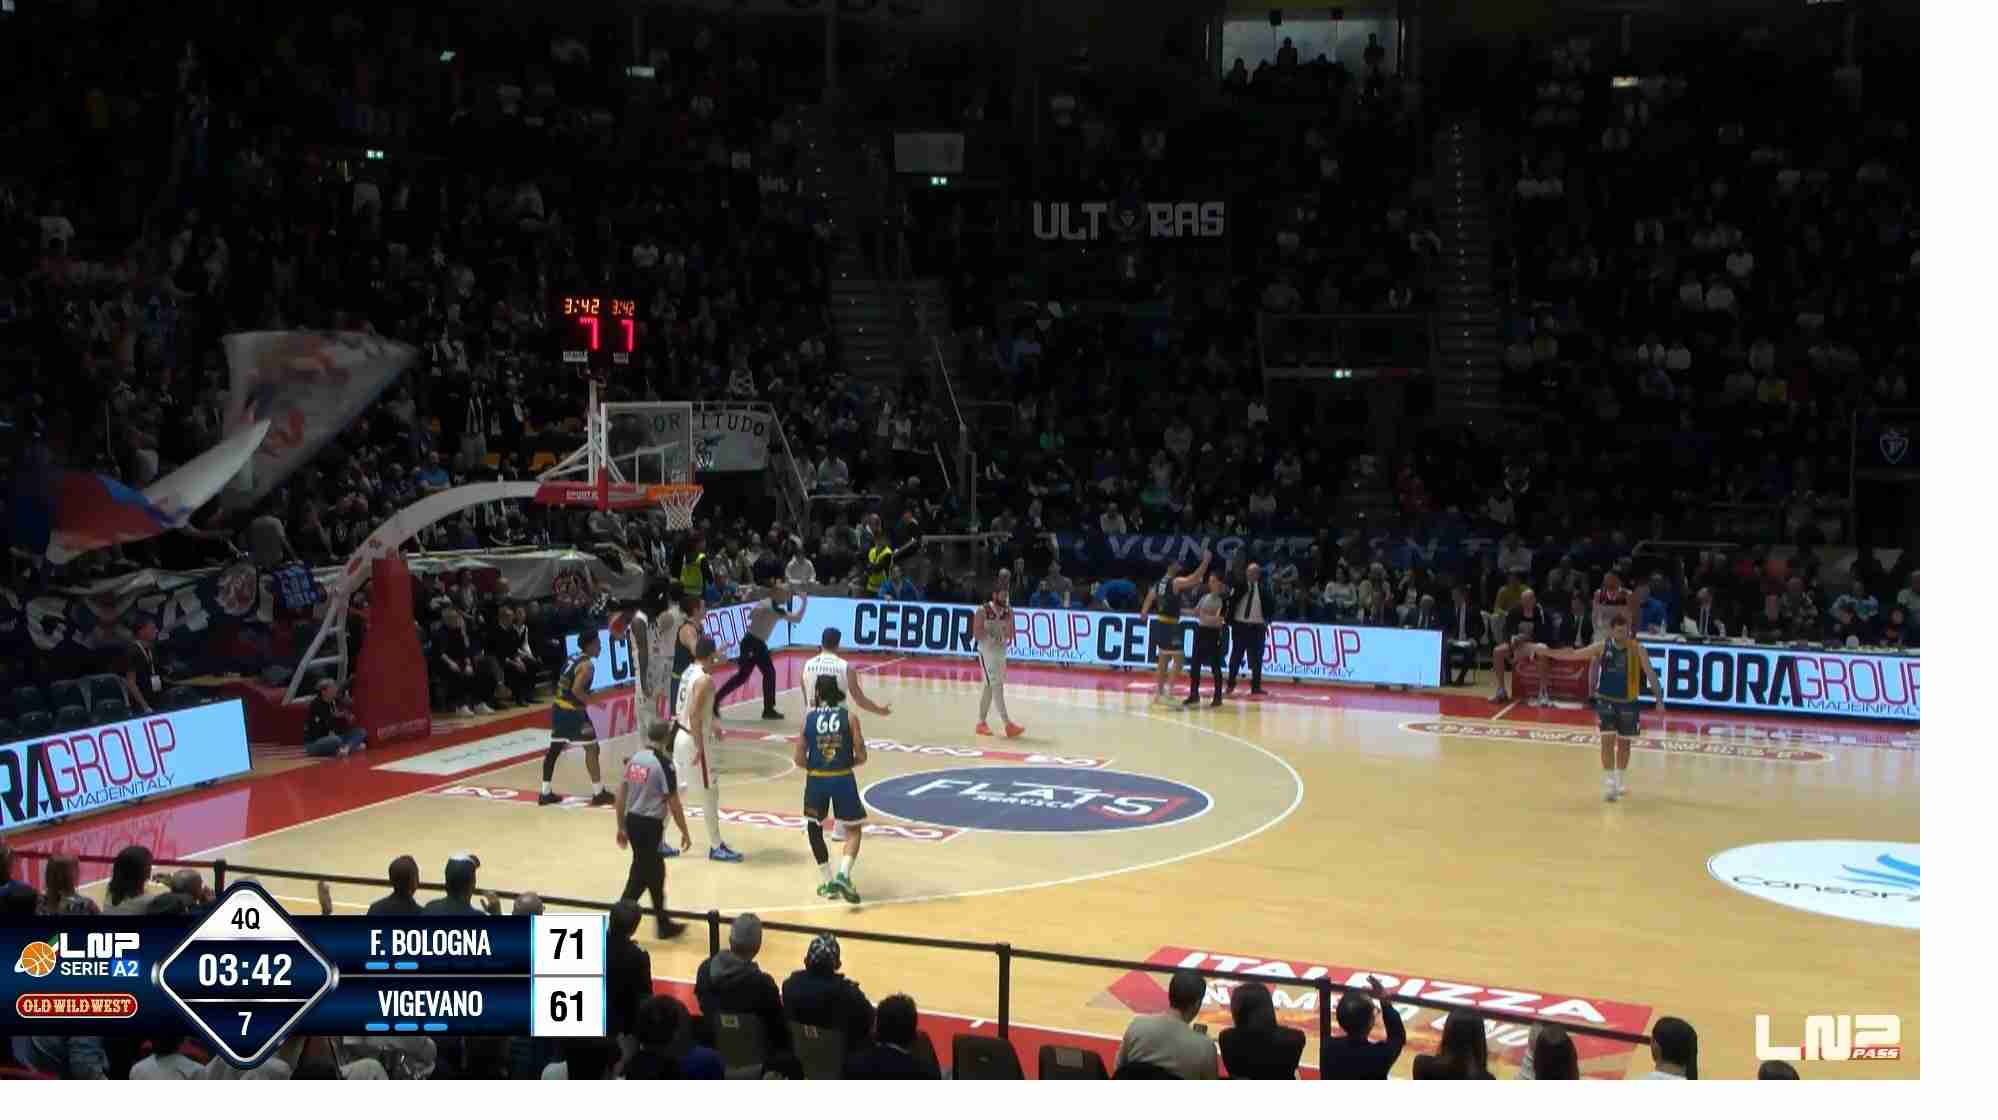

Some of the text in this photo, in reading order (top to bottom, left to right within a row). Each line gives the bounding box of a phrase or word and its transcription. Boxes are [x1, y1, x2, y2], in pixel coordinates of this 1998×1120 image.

[564, 297, 600, 315] 3:42
[579, 316, 600, 351] 7
[816, 713, 841, 734] 66
